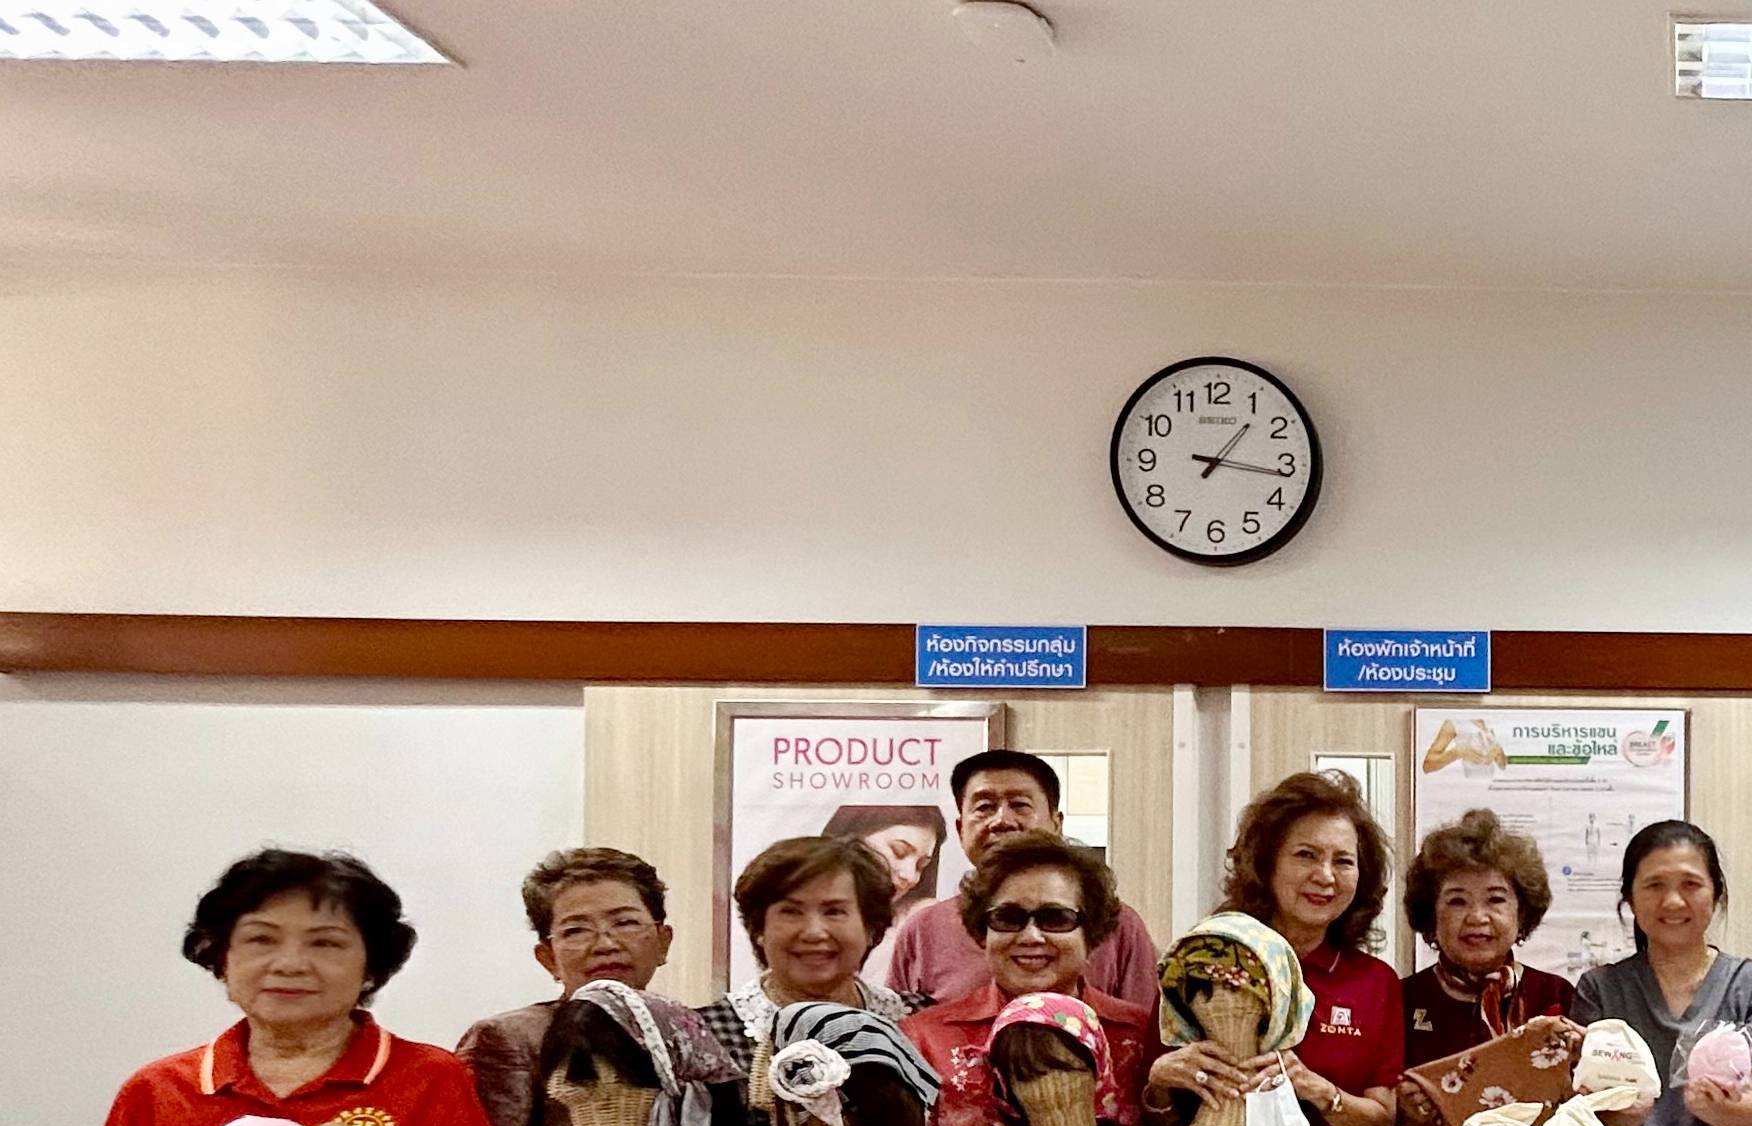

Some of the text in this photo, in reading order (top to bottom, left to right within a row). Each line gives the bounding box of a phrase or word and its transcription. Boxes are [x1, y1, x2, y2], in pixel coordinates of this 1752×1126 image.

[1173, 390, 1195, 413] 11
[1203, 382, 1232, 405] 12
[1247, 392, 1257, 414] 1
[1145, 414, 1172, 437] 10
[1270, 416, 1288, 439] 2
[1138, 448, 1157, 472] 9
[1276, 452, 1296, 478] 3
[1145, 484, 1166, 508] 8
[1266, 487, 1286, 511] 4
[1174, 509, 1192, 532] 7
[1206, 520, 1226, 543] 6
[1242, 511, 1261, 535] 5
[926, 634, 1076, 658] ห้องกิจกรรมกลุ่ม
[1338, 636, 1476, 658] ห้องพักเจ้าหน้าที่
[928, 657, 1073, 678] /ห้องให้คำปรึกษา
[1357, 663, 1456, 685] /ห้องประชุม
[773, 737, 943, 766] PRODUCT
[772, 772, 941, 791] SHOWROOM
[1320, 1022, 1362, 1037] ZONTA
